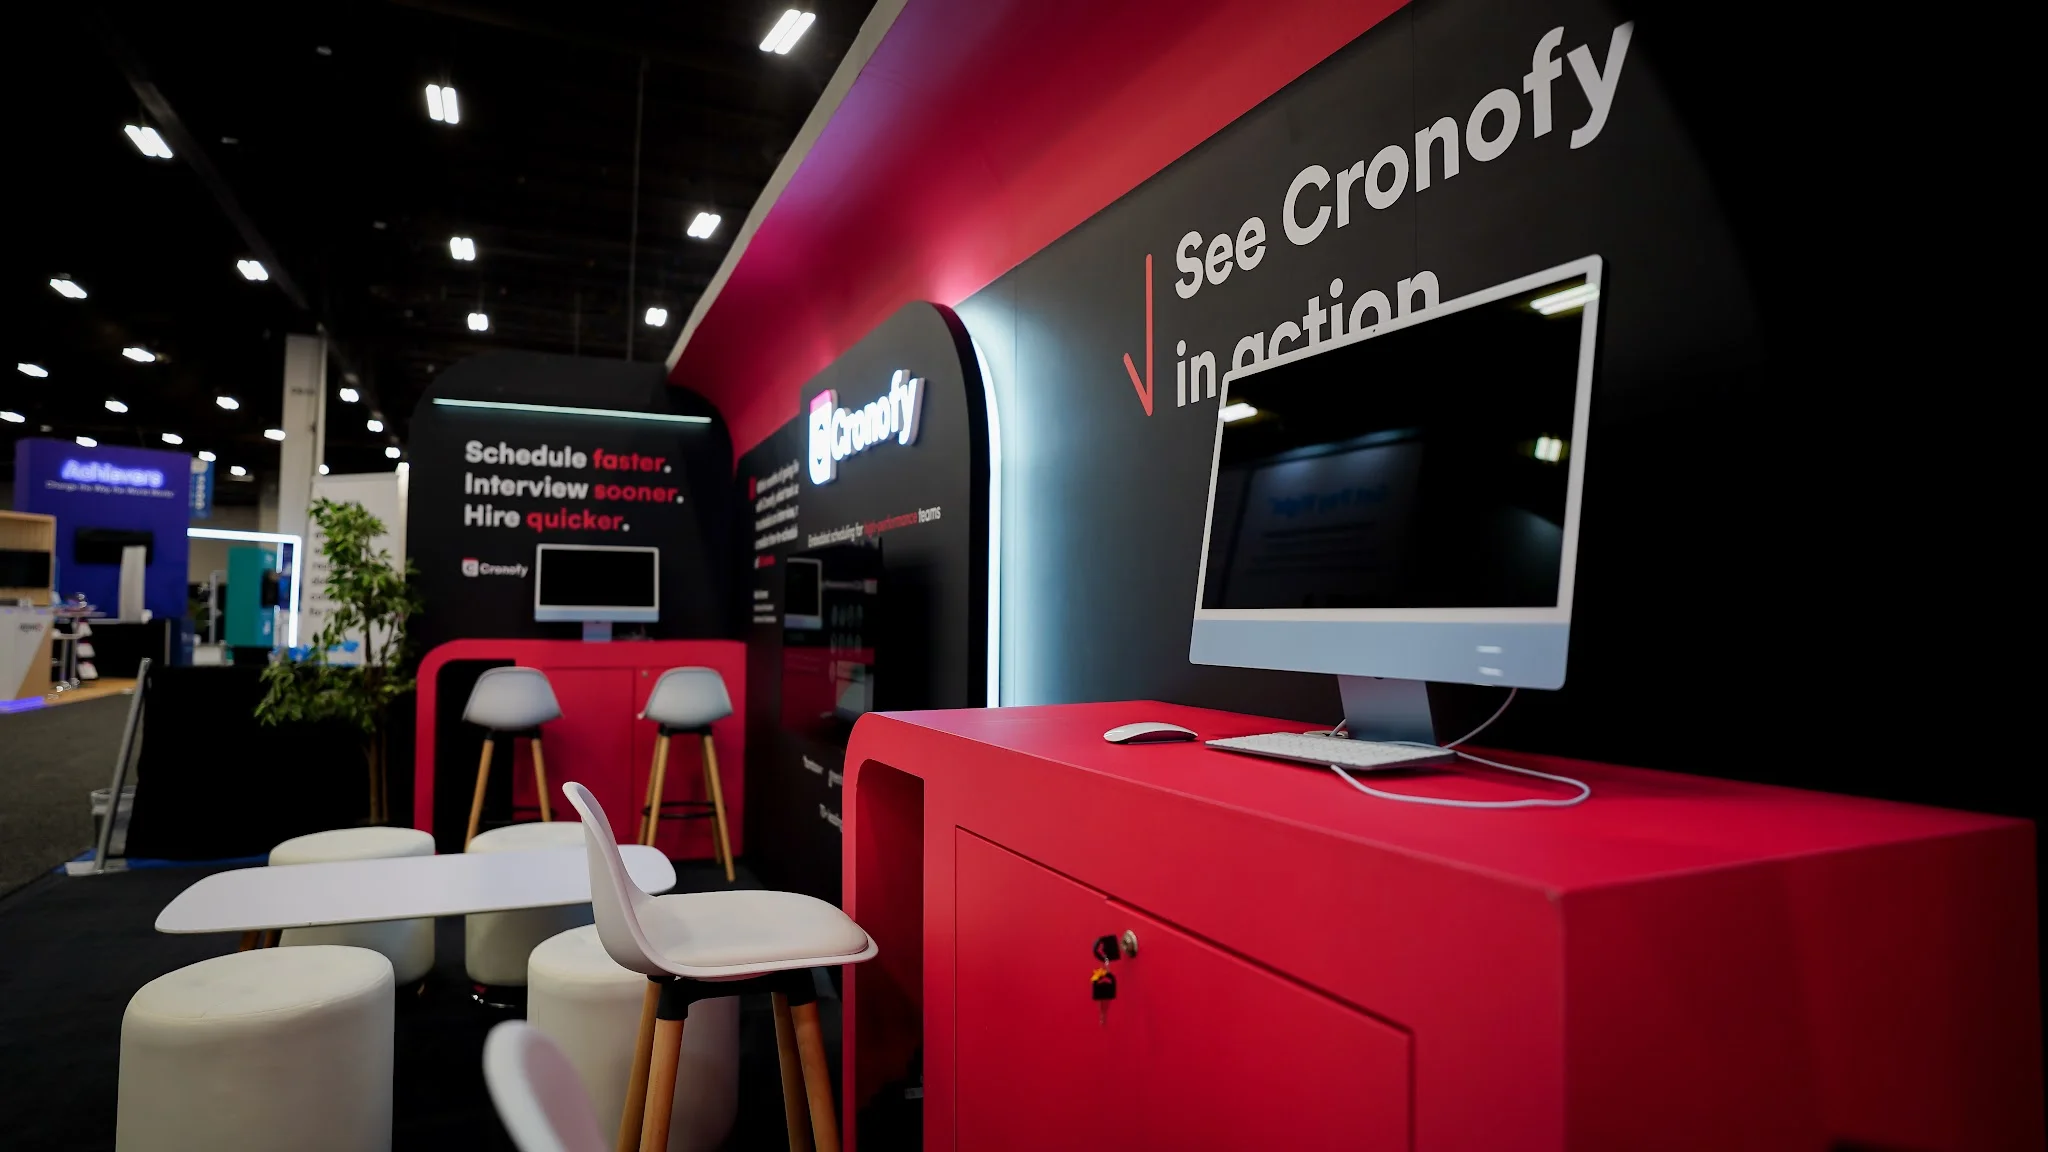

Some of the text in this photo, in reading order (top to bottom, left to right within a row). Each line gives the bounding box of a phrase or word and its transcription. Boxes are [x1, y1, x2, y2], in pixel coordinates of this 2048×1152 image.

[1175, 20, 1634, 299] See Cronofy
[1176, 340, 1217, 408] in
[831, 369, 925, 462] Cronofy
[464, 440, 672, 473] Schedule faster.
[61, 459, 164, 488] Achievers
[464, 472, 684, 504] Interview sooner.
[464, 503, 630, 533] Hire quicker.
[918, 505, 941, 523] teams
[479, 562, 529, 578] Cronofy
